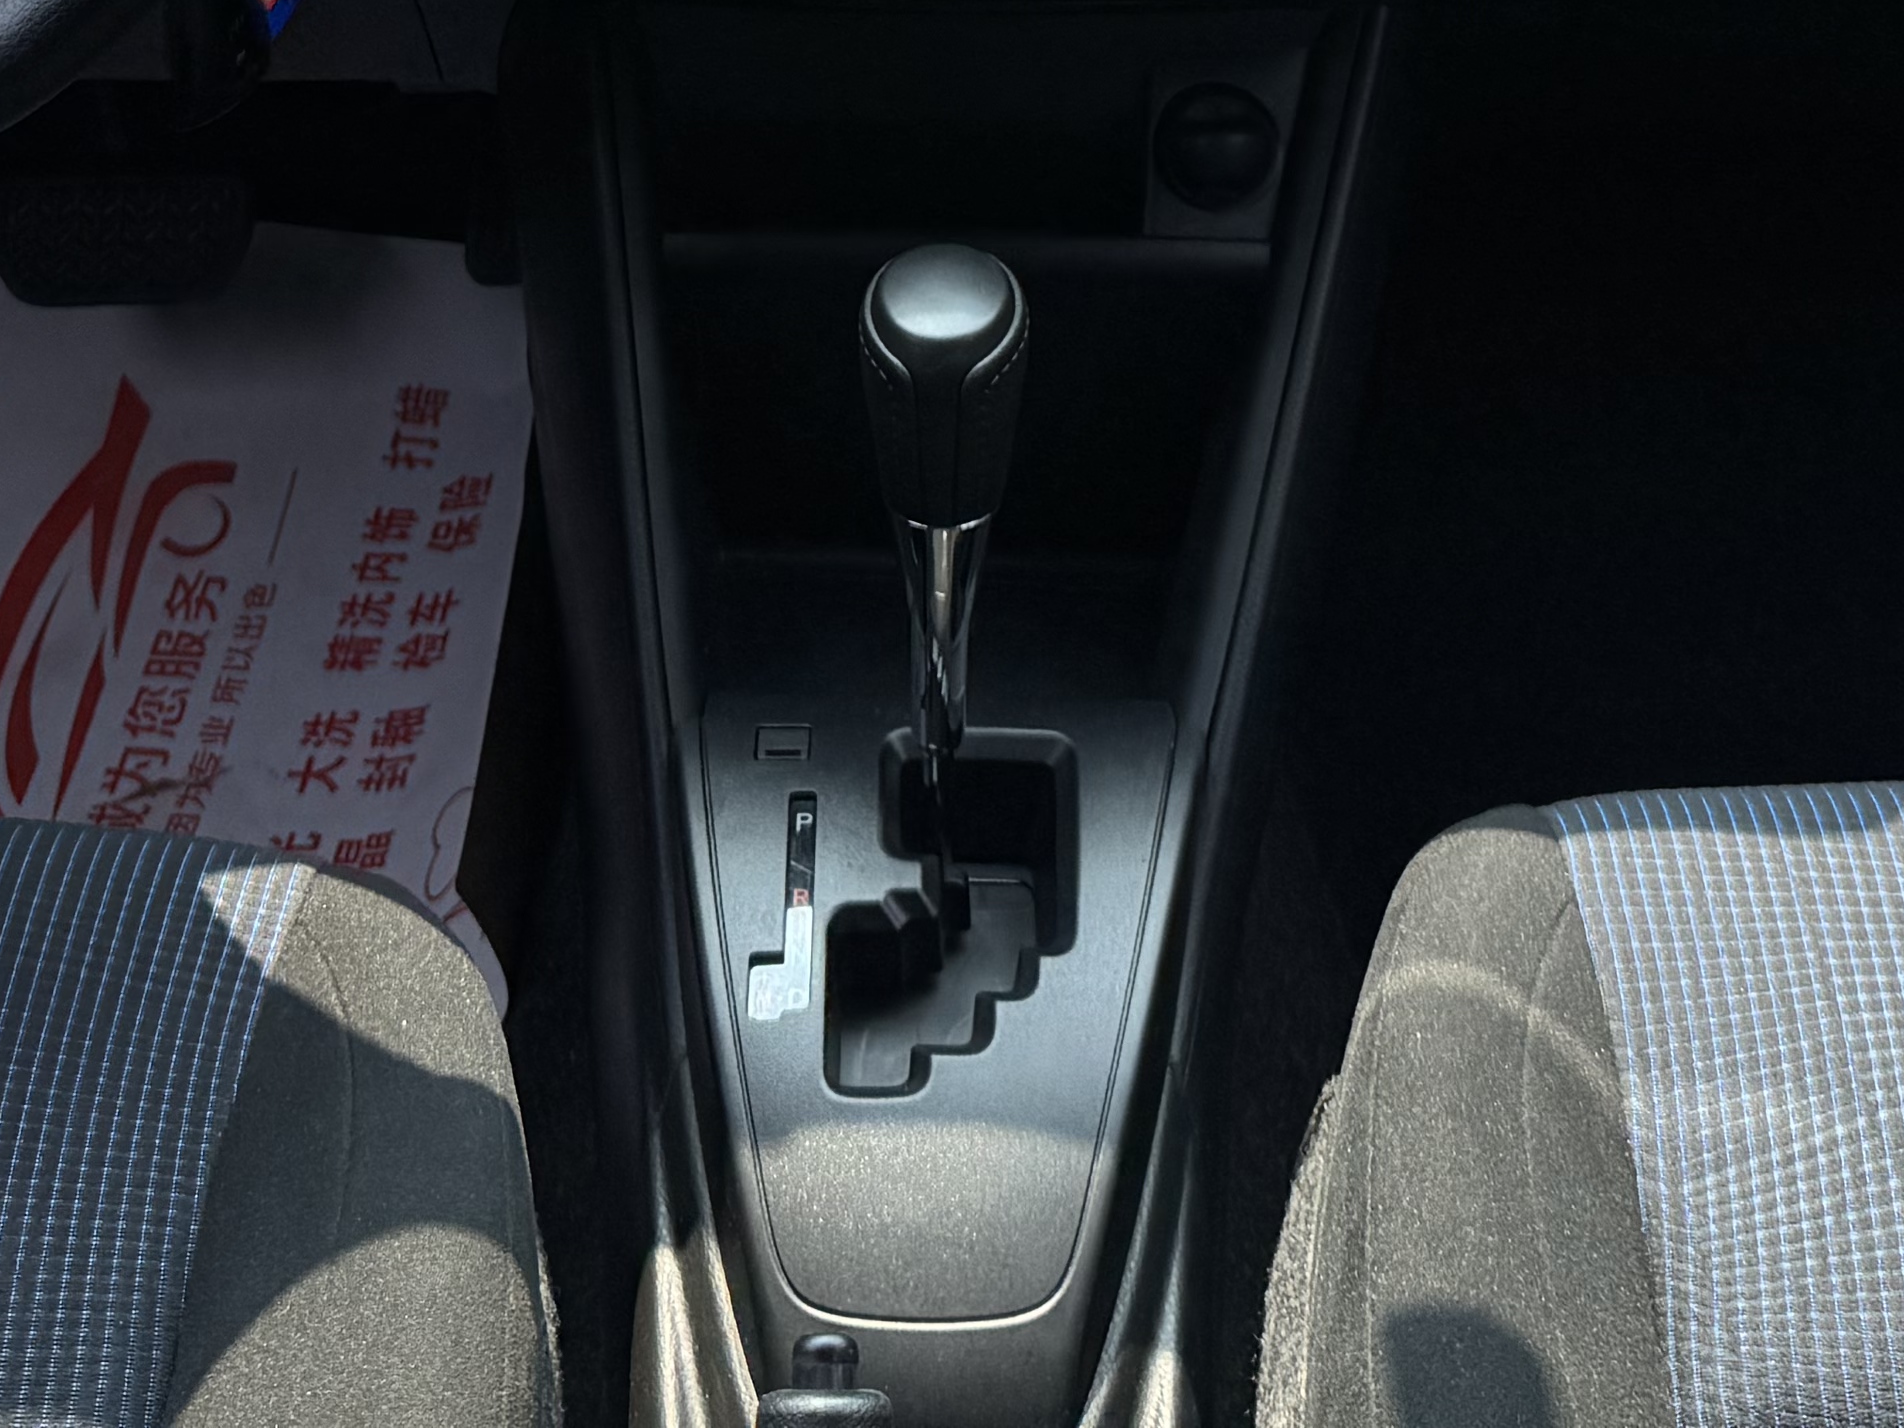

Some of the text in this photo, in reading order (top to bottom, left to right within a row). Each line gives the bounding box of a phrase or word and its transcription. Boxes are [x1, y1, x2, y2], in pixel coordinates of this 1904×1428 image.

[381, 381, 451, 472] 打蜡
[427, 470, 495, 554] 保险
[322, 505, 420, 673] 精洗内饰
[392, 586, 462, 673] 检车
[209, 581, 278, 706] 所以出色
[287, 708, 360, 796] 大洗
[357, 702, 431, 794] 封釉
[795, 812, 813, 833] P
[792, 888, 809, 906] R
